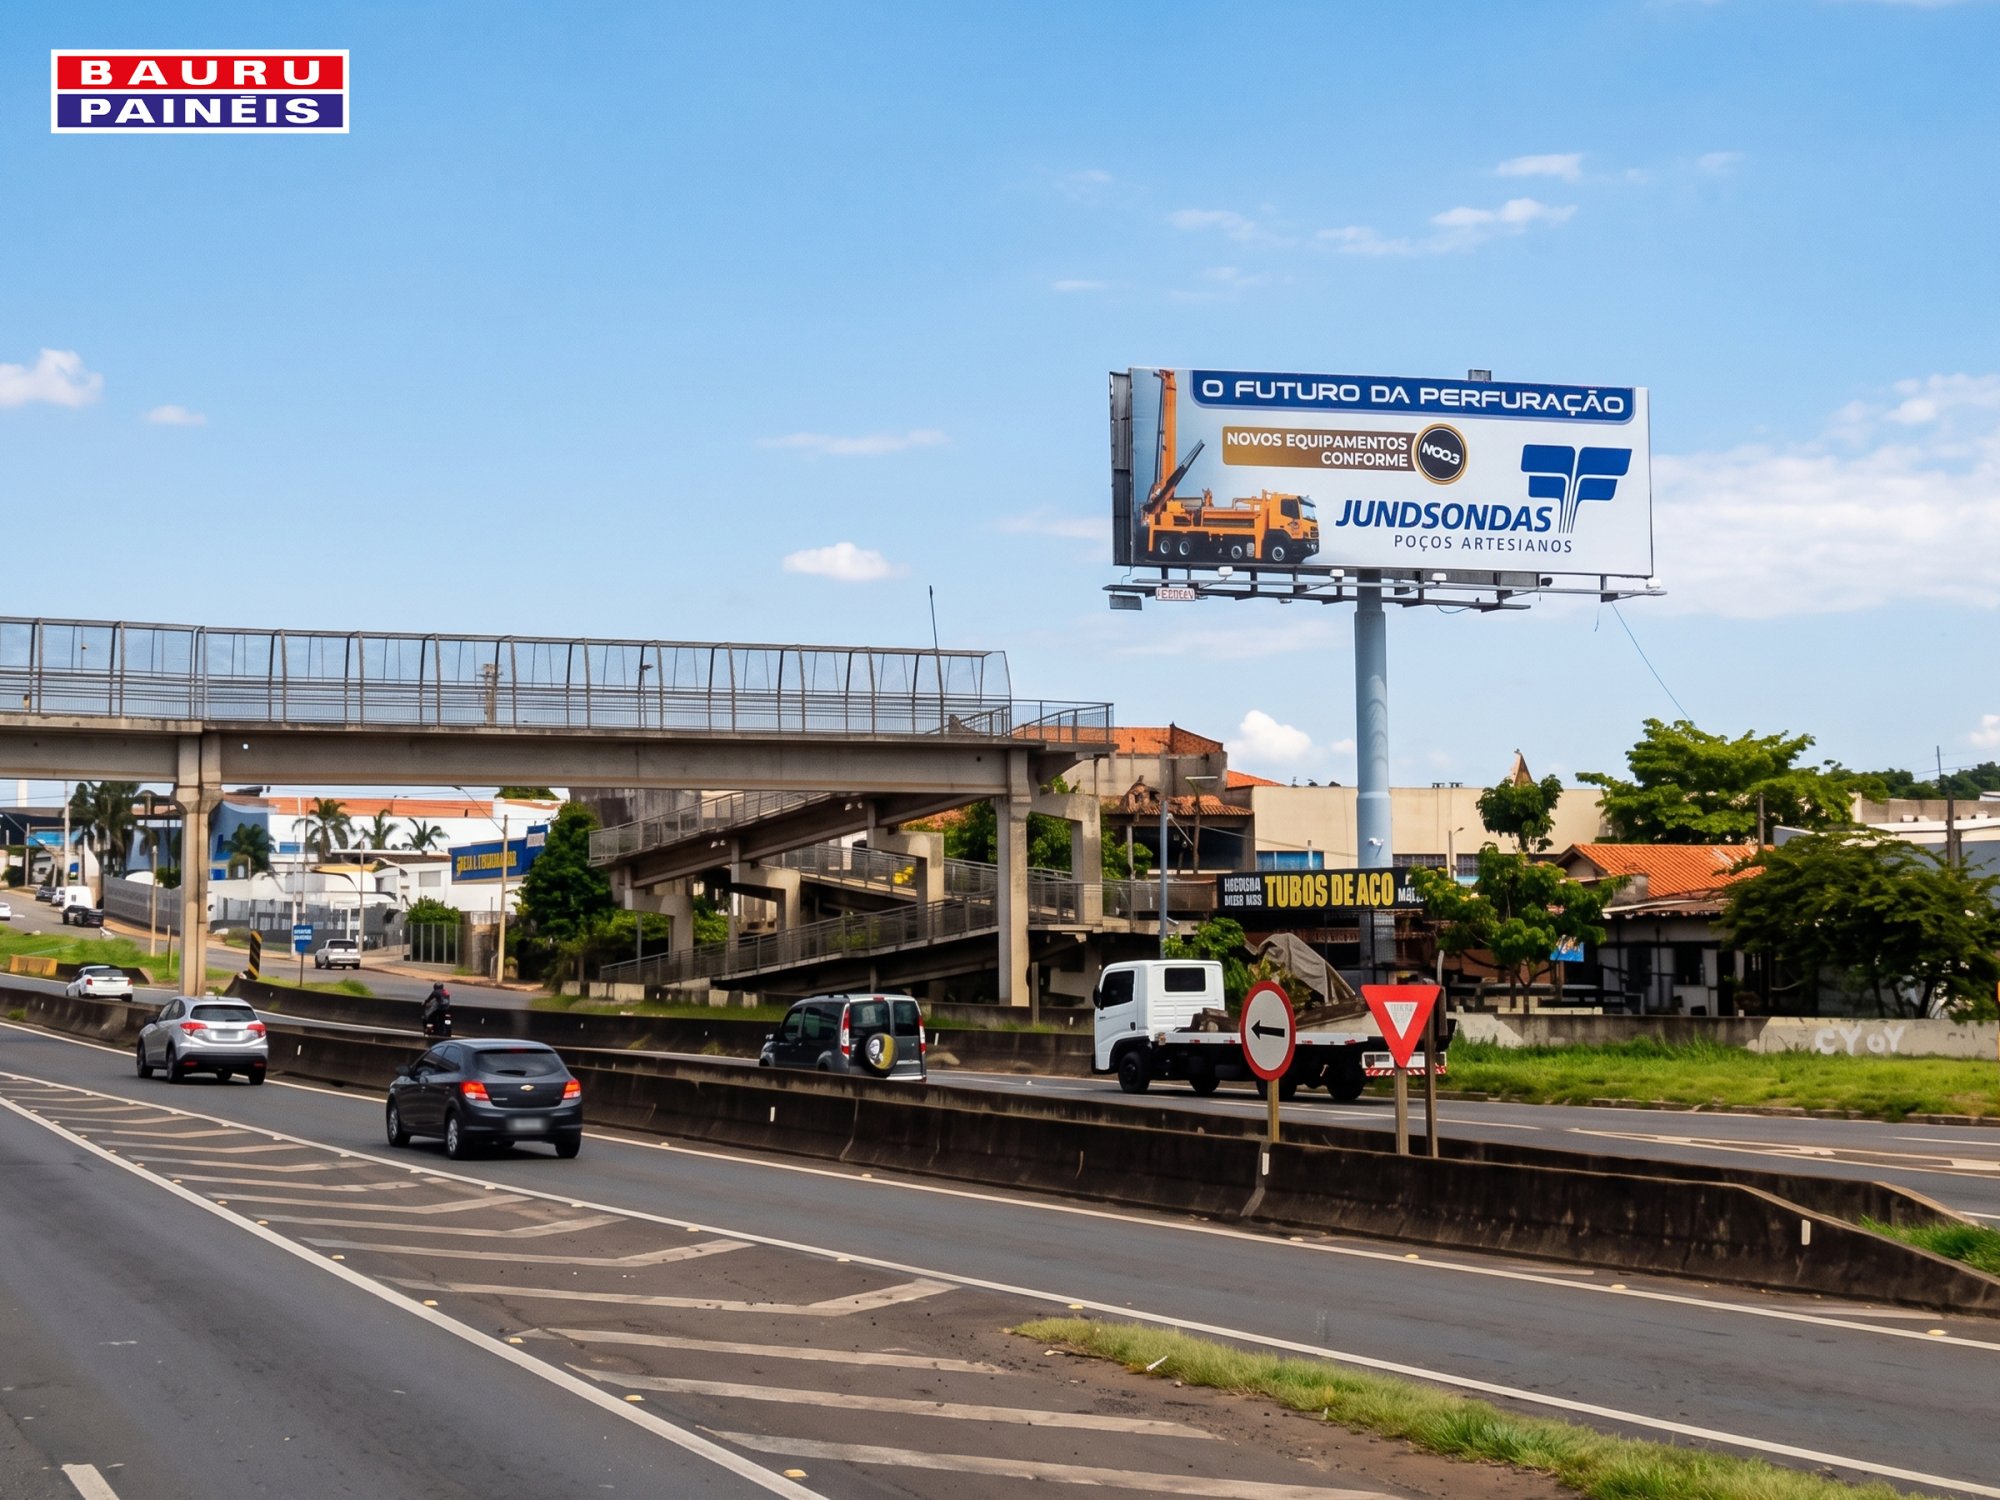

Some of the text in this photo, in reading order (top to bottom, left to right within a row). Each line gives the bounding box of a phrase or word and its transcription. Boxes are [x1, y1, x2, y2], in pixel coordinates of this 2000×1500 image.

[1202, 379, 1625, 416] O FUTURO DA PERFURAÇÃO
[1227, 432, 1408, 451] NOVOS EQUIPAMENTOS
[1321, 451, 1408, 468] CONFORME
[1335, 499, 1553, 533] JUNDSONDAS
[1394, 534, 1573, 554] POÇOS ARTESIANOS
[1264, 874, 1328, 908] TUBOS
[1331, 873, 1354, 906] DE
